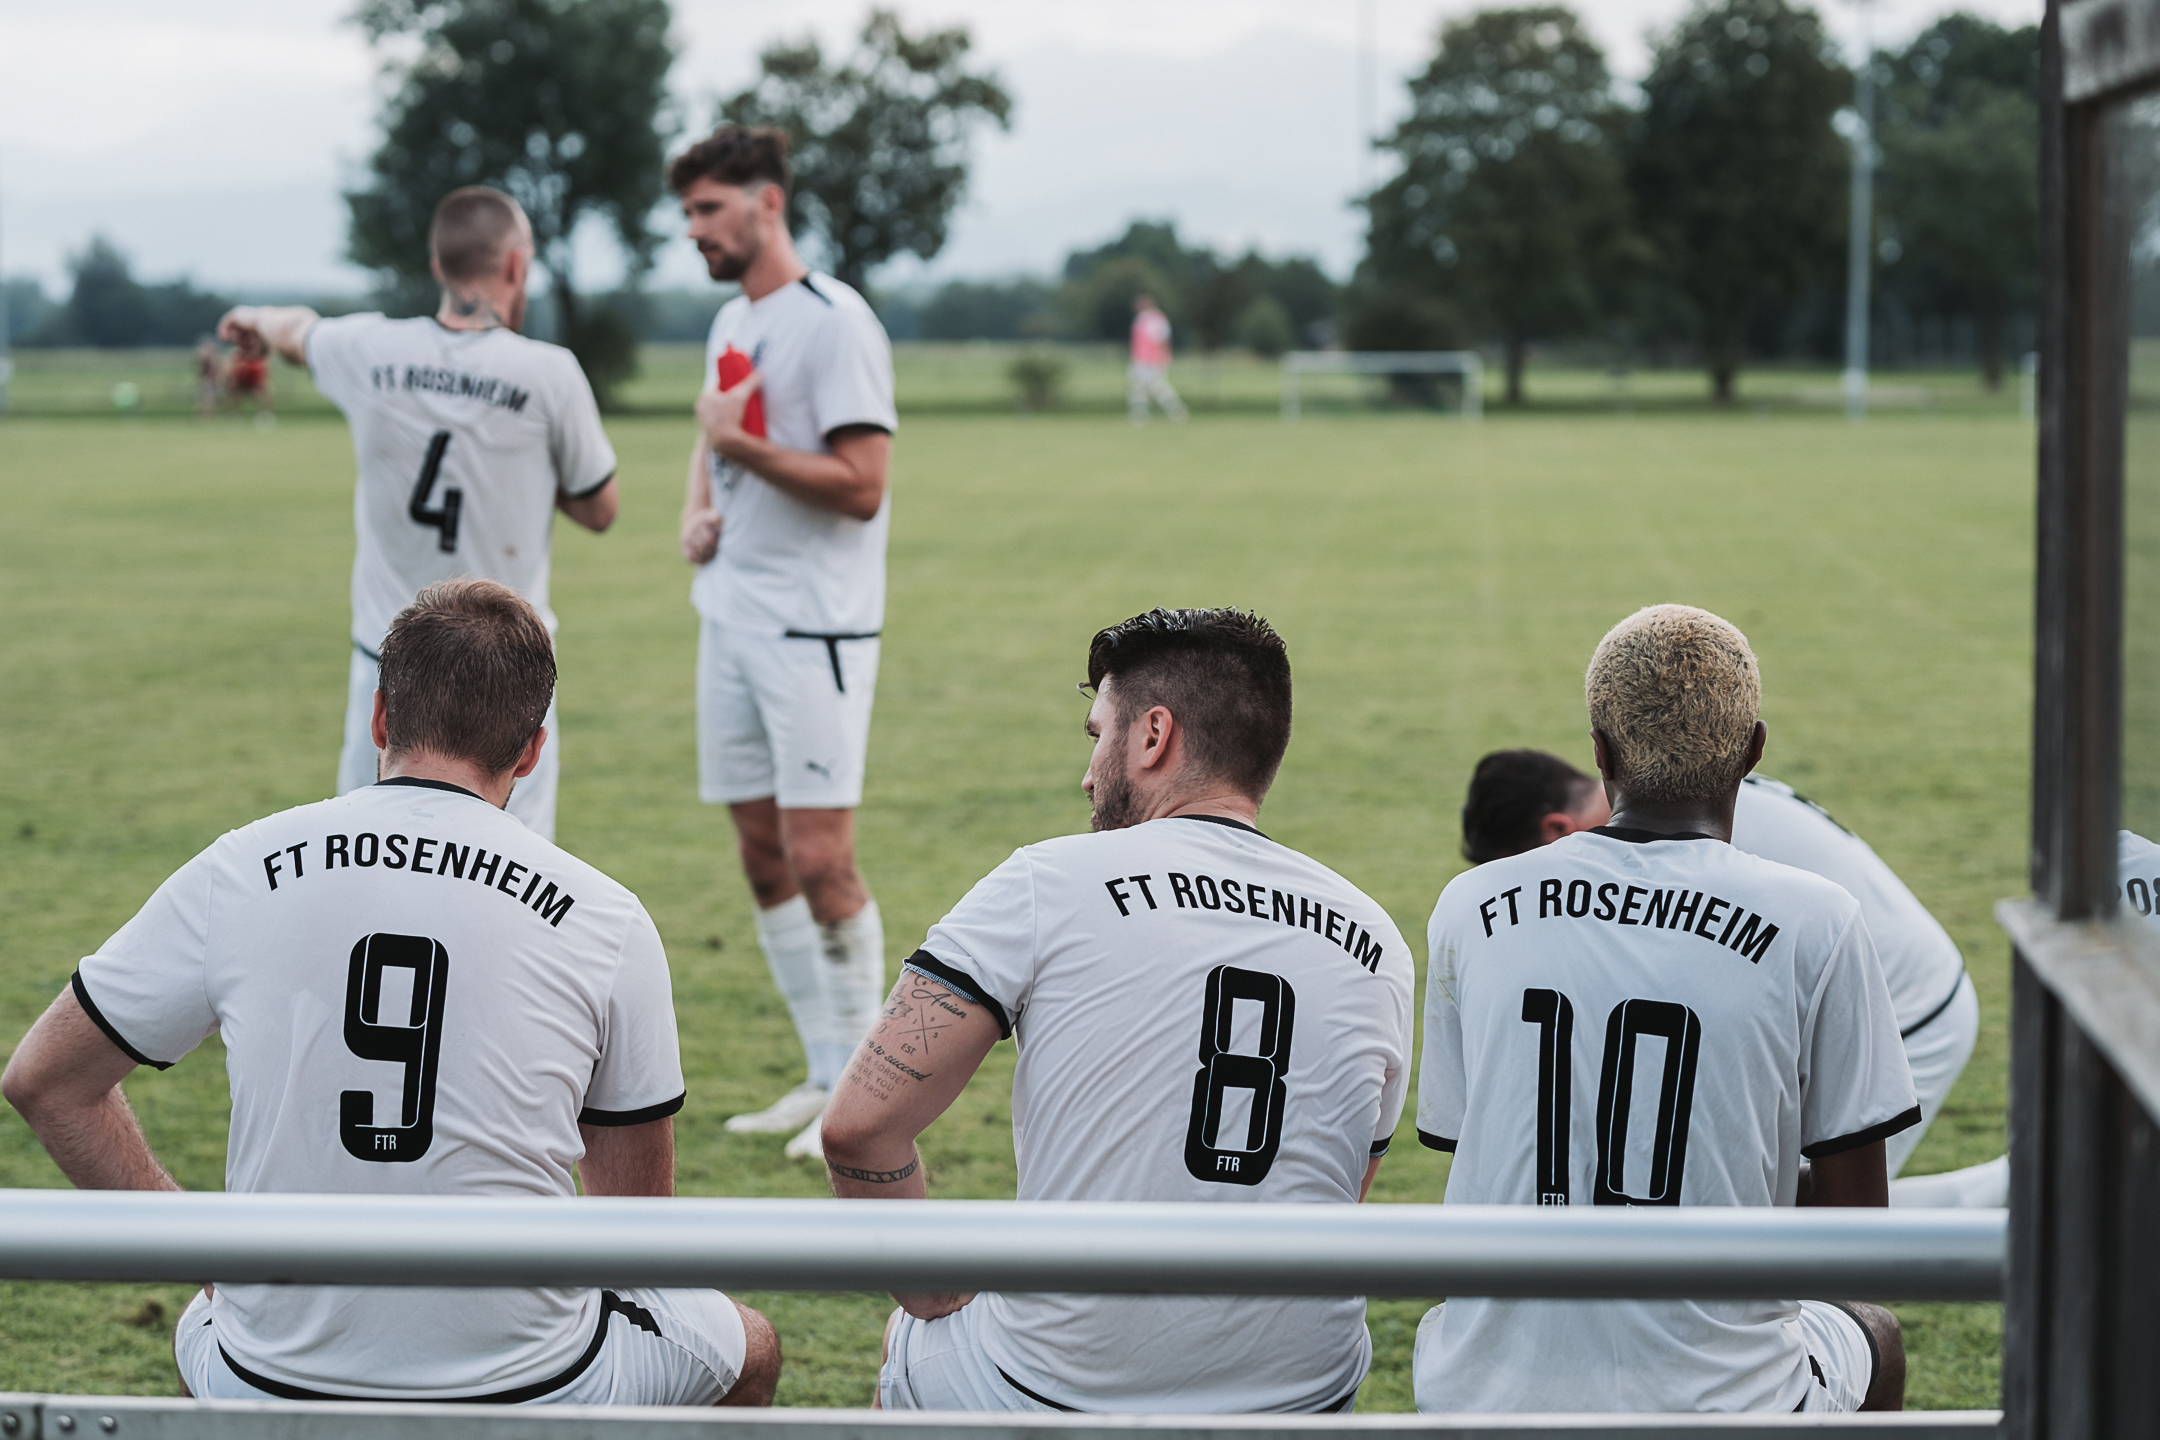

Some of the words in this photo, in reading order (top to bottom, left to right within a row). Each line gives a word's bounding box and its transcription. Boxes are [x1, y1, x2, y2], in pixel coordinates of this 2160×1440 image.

[402, 364, 532, 415] ROSENHEIM
[407, 430, 464, 555] 4
[263, 840, 308, 891] FT
[325, 832, 575, 928] ROSENHEIM
[1104, 874, 1158, 917] FT
[1167, 872, 1383, 975] ROSENHEIM
[1479, 886, 1522, 938] FT
[1539, 878, 1780, 965] ROSENHEIM
[339, 932, 450, 1163] 9
[884, 1055, 933, 1082] succeed
[863, 1081, 889, 1101] FROM
[874, 1060, 909, 1087] FORGET
[876, 1076, 895, 1092] YOU
[1183, 964, 1296, 1187] 8
[1521, 987, 1702, 1207] 10
[374, 1134, 397, 1151] FTR
[1216, 1155, 1241, 1173] FTR
[1542, 1192, 1566, 1208] FTR
